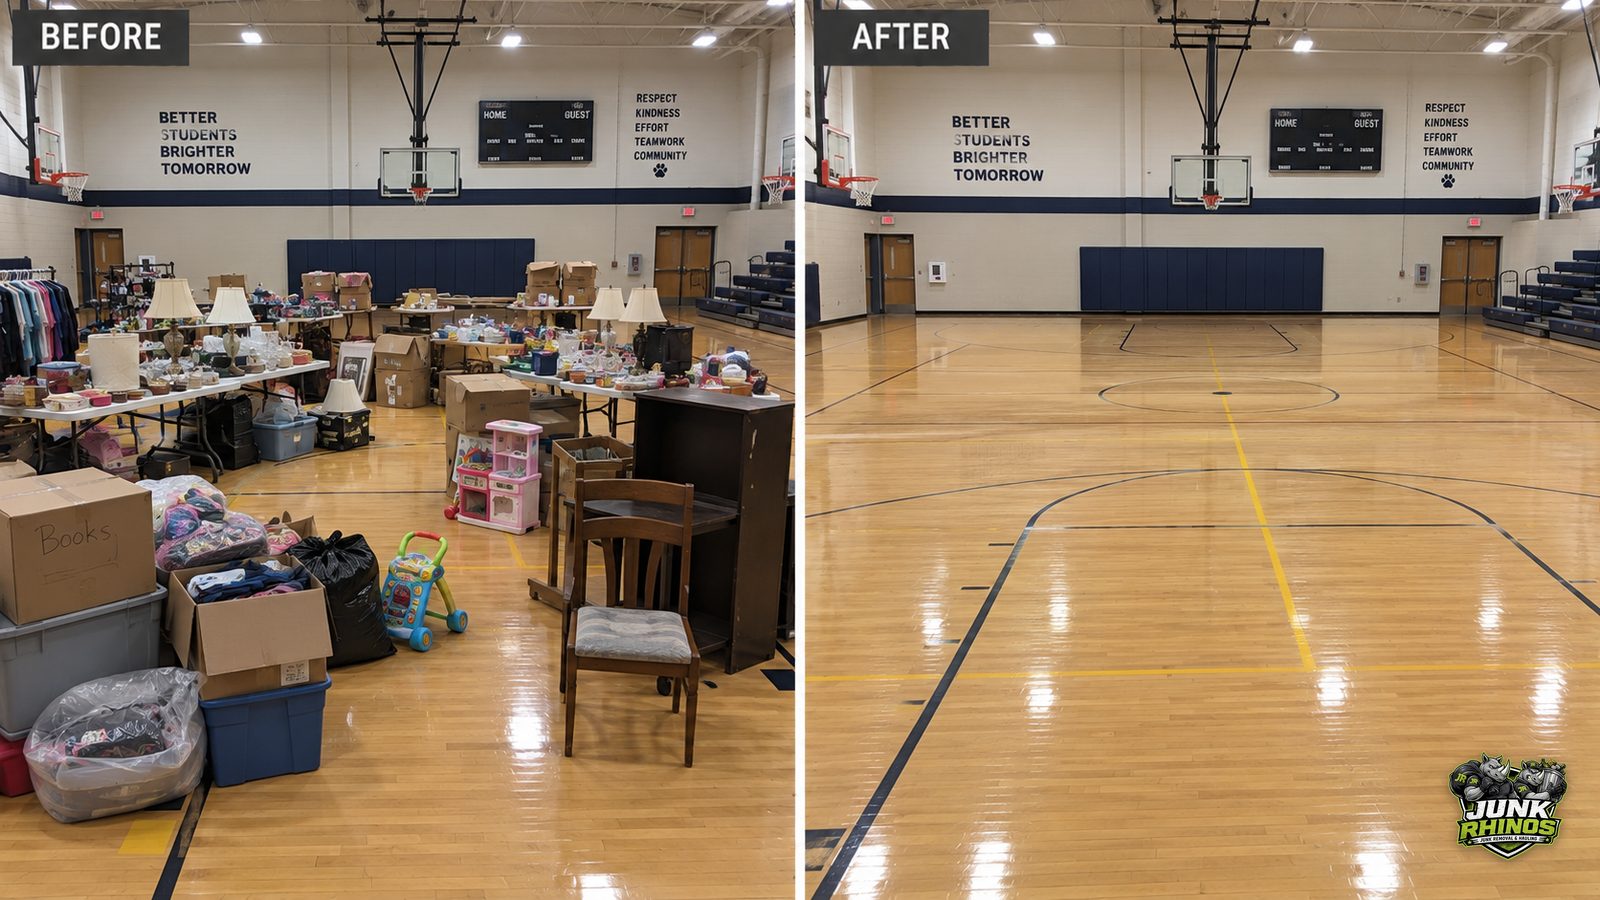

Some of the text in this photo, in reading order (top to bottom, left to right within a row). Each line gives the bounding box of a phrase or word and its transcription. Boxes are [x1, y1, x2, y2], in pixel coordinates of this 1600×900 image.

[636, 93, 677, 103] RESPECT
[635, 108, 681, 118] KINDNESS
[1425, 103, 1466, 113] RESPECT
[159, 111, 217, 124] BETTER
[483, 110, 507, 119] HOME
[564, 110, 590, 119] GUEST
[634, 122, 669, 132] EFFORT
[952, 116, 1010, 129] BETTER
[1274, 119, 1298, 128] HOME
[1354, 119, 1379, 128] GUEST
[1424, 118, 1469, 128] KINDNESS
[161, 129, 237, 141] STUDENTS
[1423, 132, 1458, 142] EFFORT
[634, 137, 685, 147] TEAMWORK
[954, 134, 1030, 147] STUDENTS
[160, 146, 235, 158] BRIGHTER
[633, 151, 687, 161] COMMUNITY
[1423, 147, 1473, 157] TEAMWORK
[953, 151, 1028, 164] BRIGHTER
[161, 163, 251, 175] TOMORROW
[1422, 161, 1475, 171] COMMUNITY
[954, 169, 1044, 182] TOMORROW
[34, 519, 111, 555] Books
